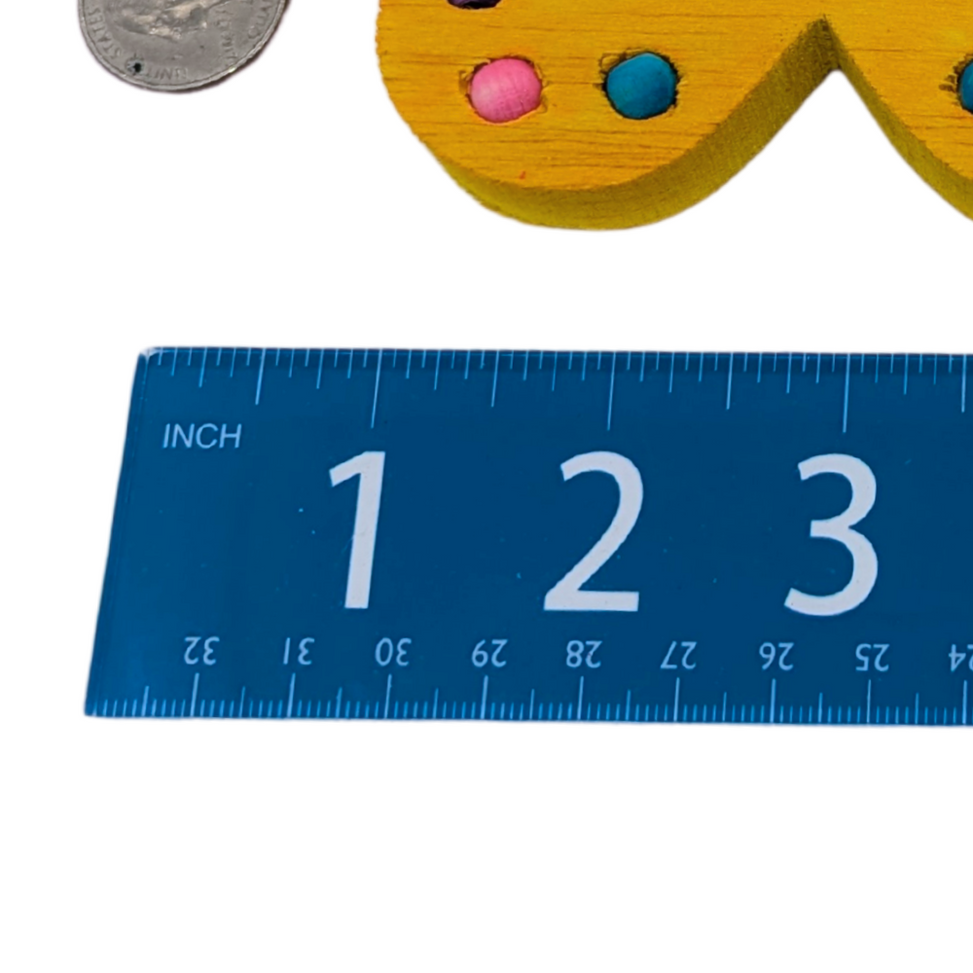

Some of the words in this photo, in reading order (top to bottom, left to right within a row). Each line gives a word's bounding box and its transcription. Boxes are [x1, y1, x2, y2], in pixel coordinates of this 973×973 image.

[162, 422, 242, 450] INCH
[330, 452, 384, 608] 1
[545, 452, 642, 611] 2
[786, 454, 877, 615] 3
[183, 635, 221, 666] 32
[282, 636, 316, 666] 31
[374, 636, 412, 667] 30
[471, 638, 509, 668] 29
[565, 639, 603, 669] 28
[659, 640, 697, 670] 27
[758, 641, 795, 671] 26
[855, 643, 890, 673] 25
